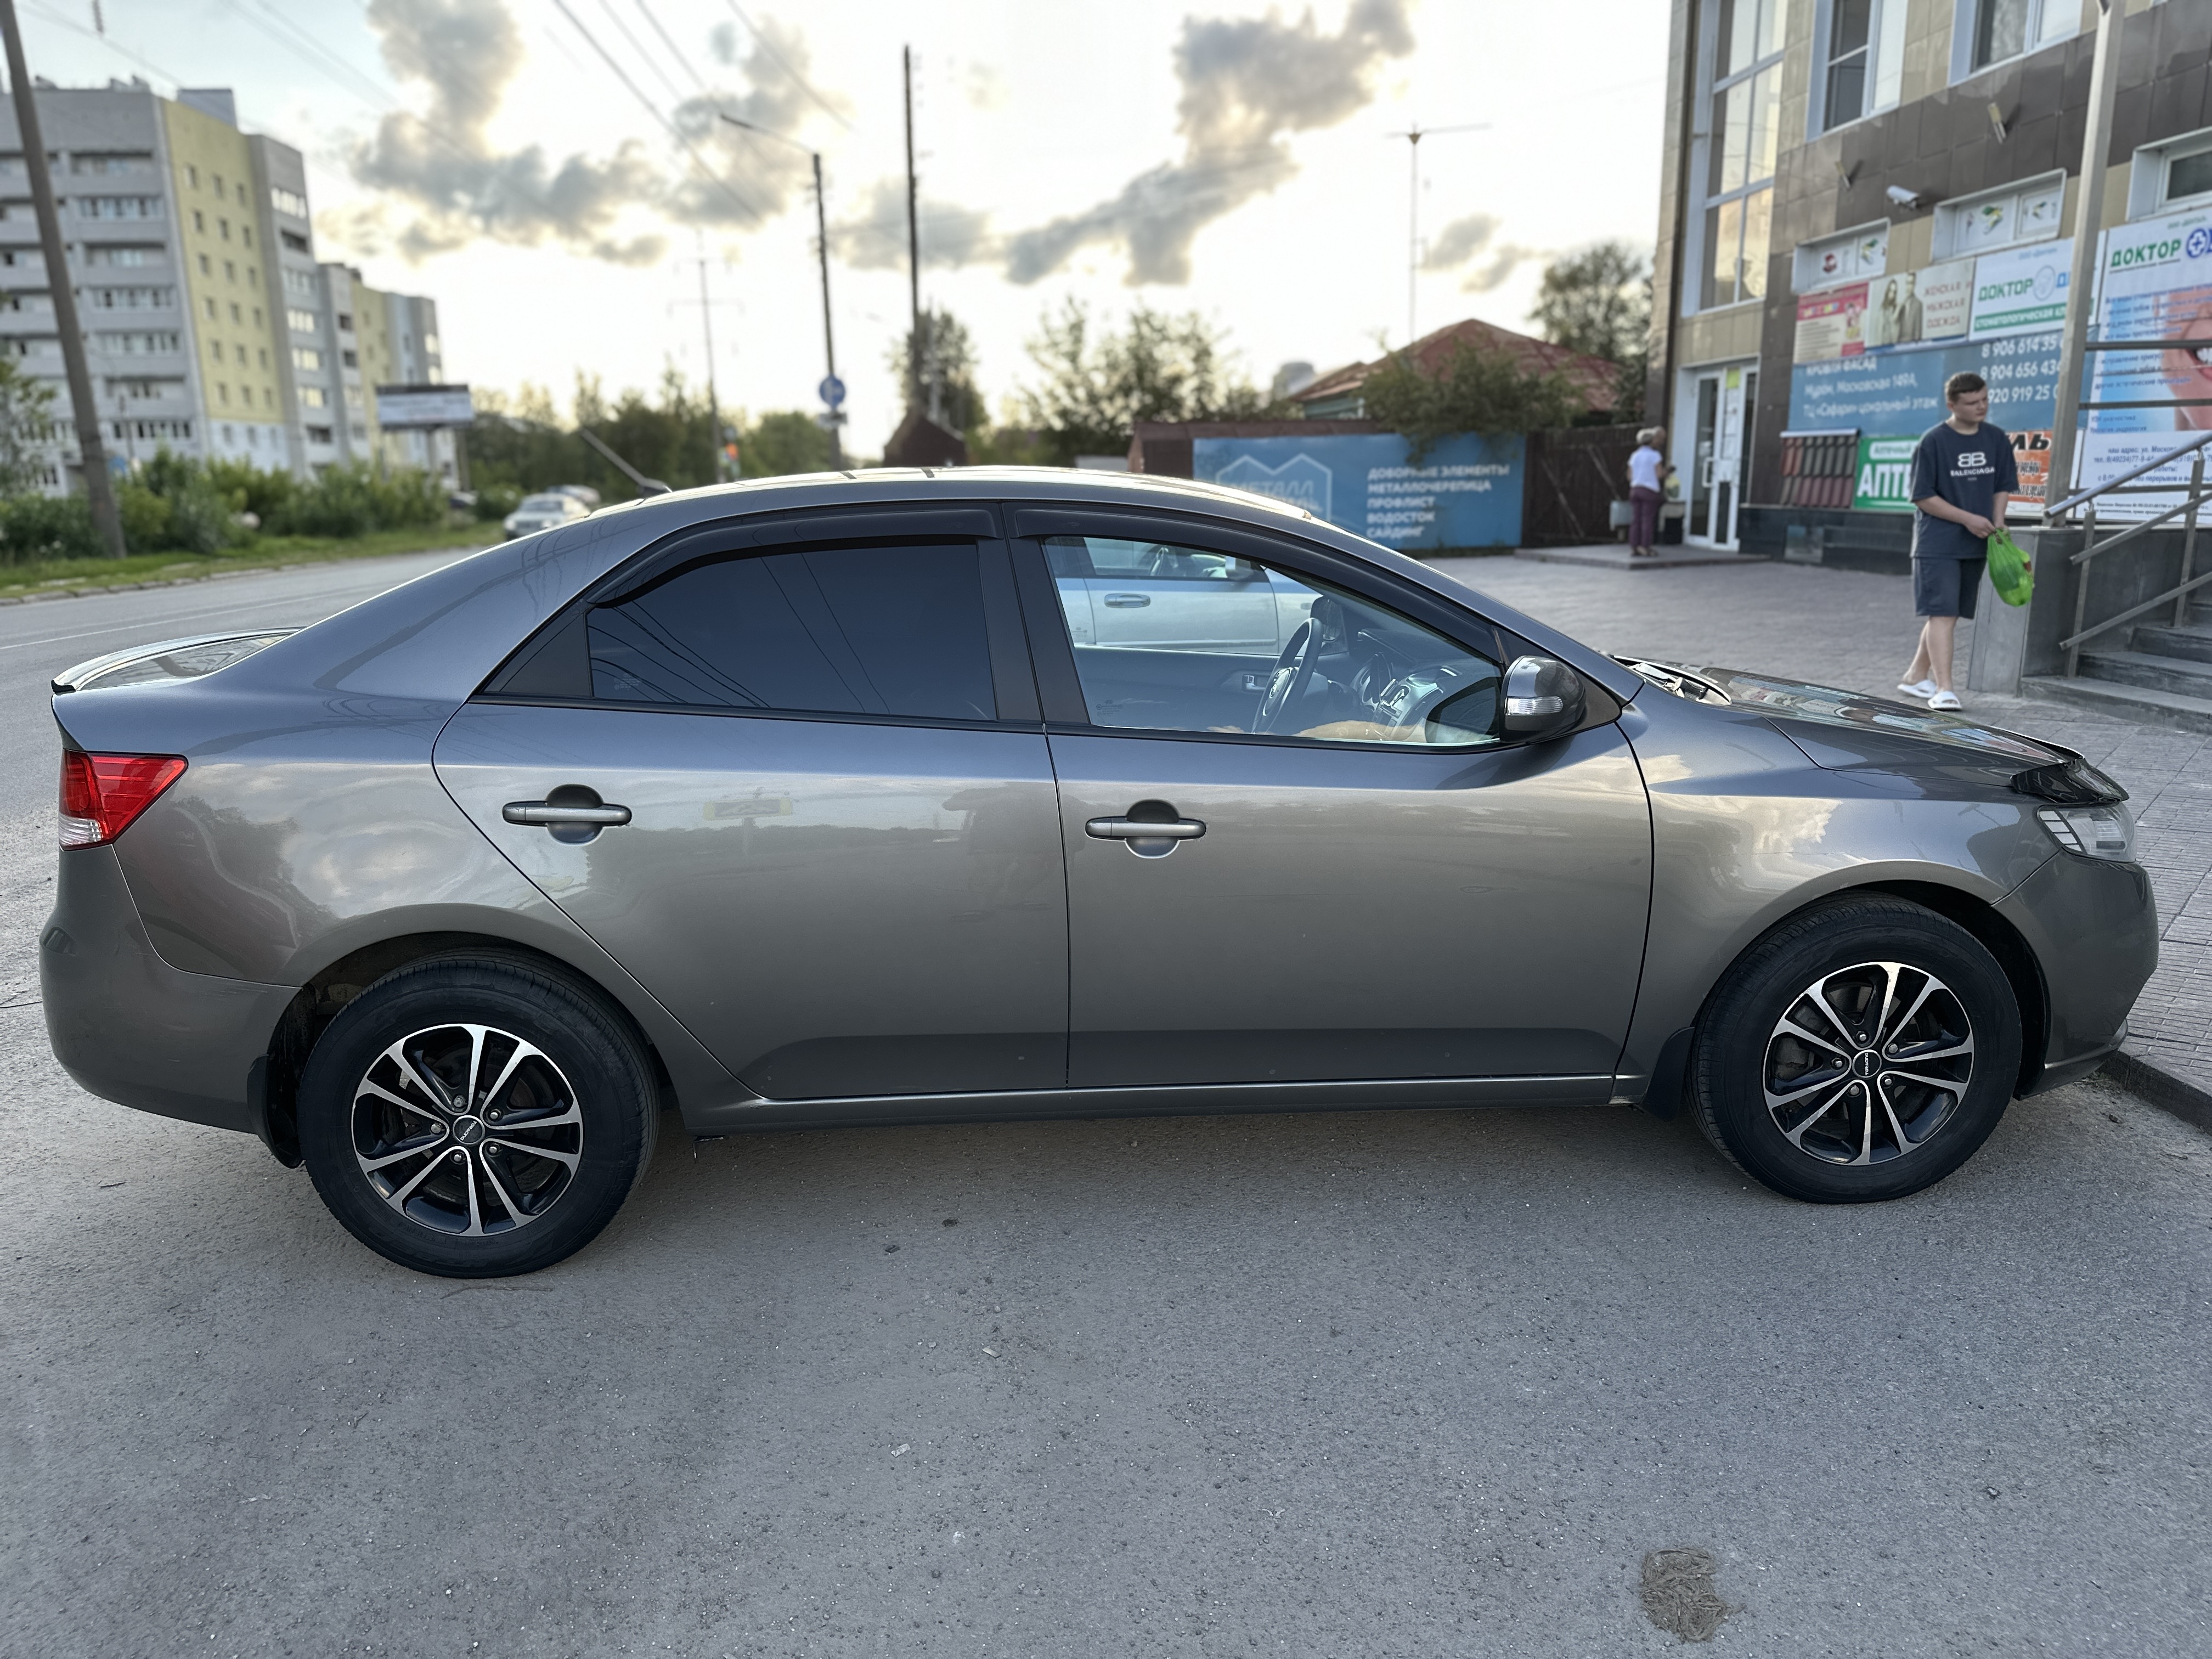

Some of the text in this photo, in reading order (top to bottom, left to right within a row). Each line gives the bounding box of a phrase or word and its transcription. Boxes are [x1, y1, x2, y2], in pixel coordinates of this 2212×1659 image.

[2111, 238, 2182, 267] ДОКТОР
[1978, 278, 2034, 302] ДОКТОР
[1993, 339, 2016, 357] 906
[2017, 337, 2040, 354] 614
[2041, 335, 2058, 351] 35
[1990, 364, 2014, 380] 904
[2015, 361, 2038, 378] 656
[2012, 385, 2033, 402] 919
[2035, 385, 2051, 400] 25
[1440, 464, 1510, 477] ЭЛЕМЕНТЫ
[1950, 467, 1995, 477] BALENCIAGA
[1367, 480, 1492, 494] МЕТАЛЛОЧЕРЕПИЦА
[1367, 496, 1436, 509] ПРОФЛИСТ
[1367, 511, 1436, 524] ВОДОСТОК
[1366, 526, 1425, 539] САЙДИНГ
